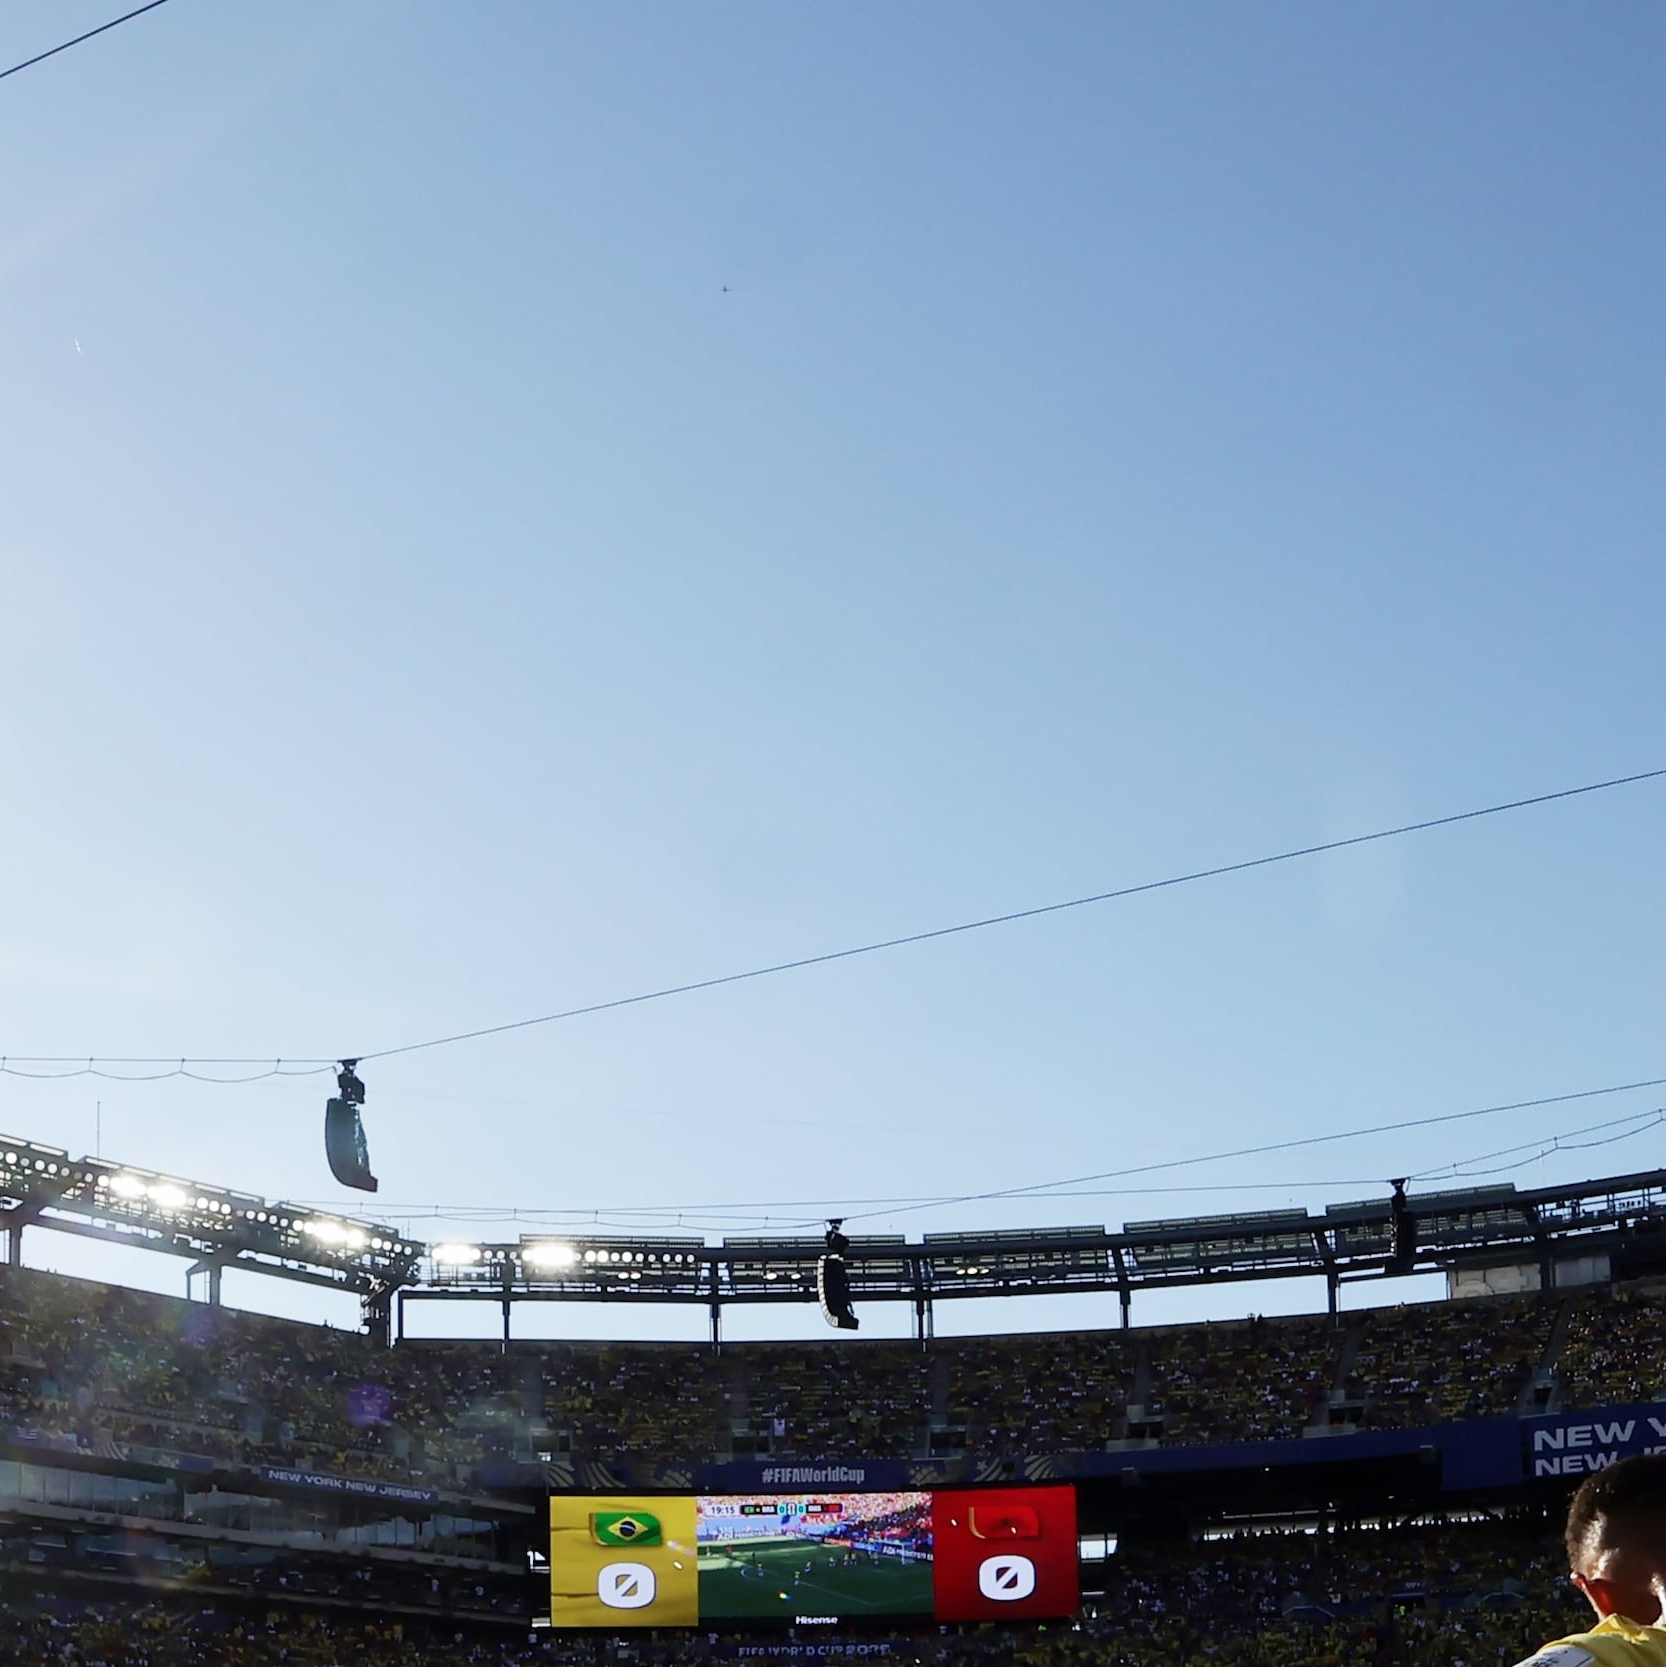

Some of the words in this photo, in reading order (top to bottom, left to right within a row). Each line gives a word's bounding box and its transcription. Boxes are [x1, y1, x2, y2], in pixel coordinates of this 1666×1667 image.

[1533, 1419, 1636, 1452] NEW
[762, 1466, 865, 1485] #FIFAWorldCup
[1534, 1450, 1619, 1476] NEW
[268, 1469, 302, 1483] NEW
[304, 1473, 342, 1489] YORK
[346, 1480, 377, 1494] NEW
[379, 1483, 432, 1501] JERSEY
[711, 1505, 735, 1514] 19:15
[598, 1562, 656, 1609] 0
[979, 1555, 1036, 1601] 0
[795, 1615, 838, 1625] Hisense
